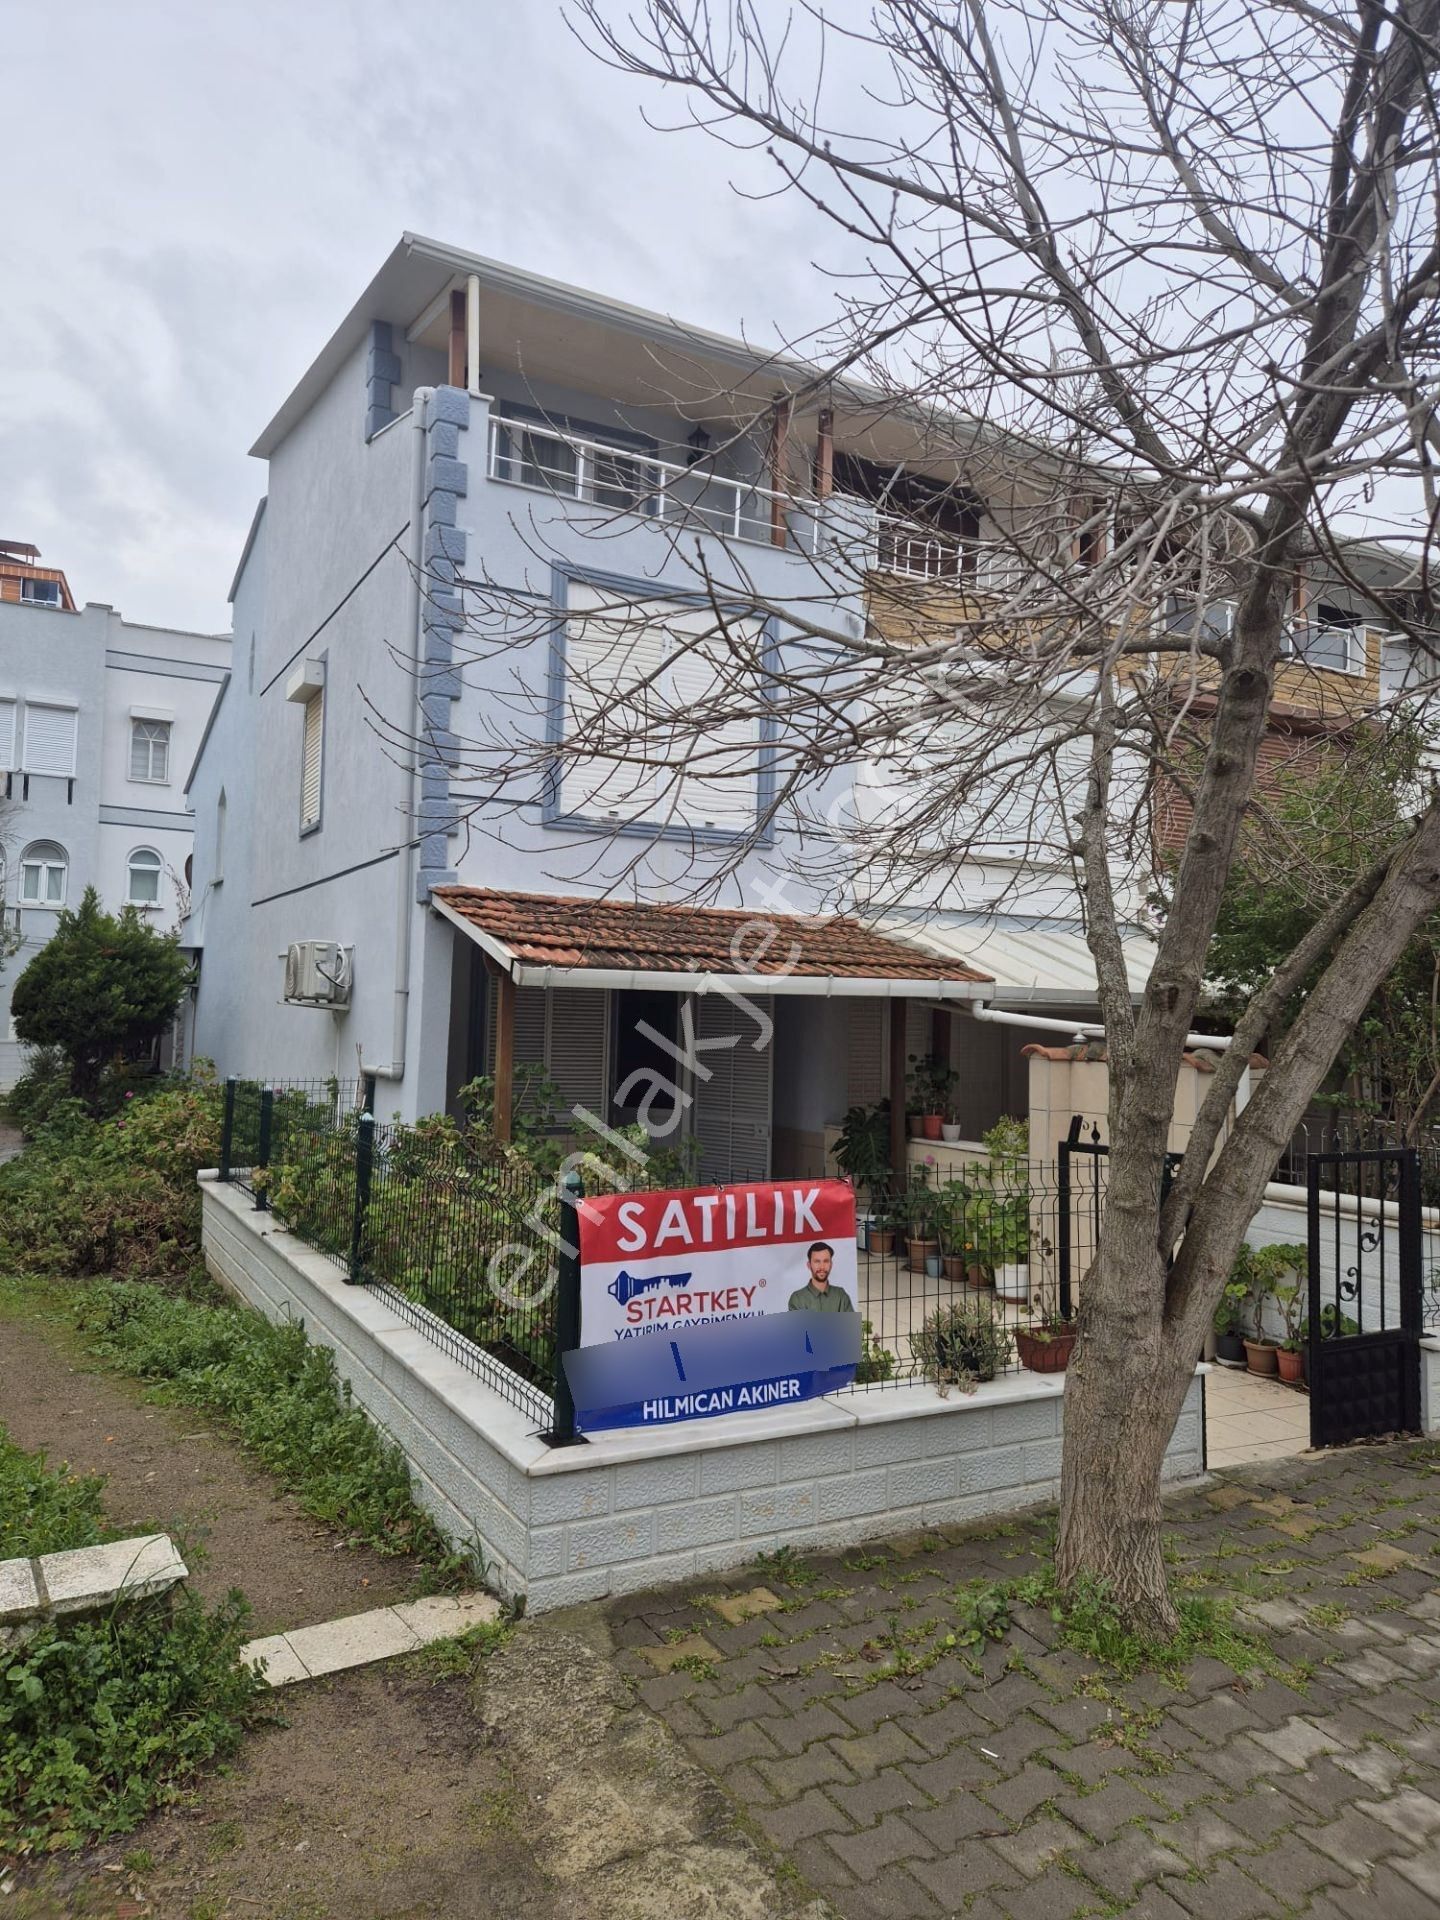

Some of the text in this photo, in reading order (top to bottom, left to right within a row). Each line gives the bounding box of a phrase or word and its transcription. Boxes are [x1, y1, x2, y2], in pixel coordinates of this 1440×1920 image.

[616, 1188, 824, 1252] SATILIK
[614, 1322, 669, 1341] YATIRIM
[643, 1379, 801, 1420] HILMICAN AKINER
